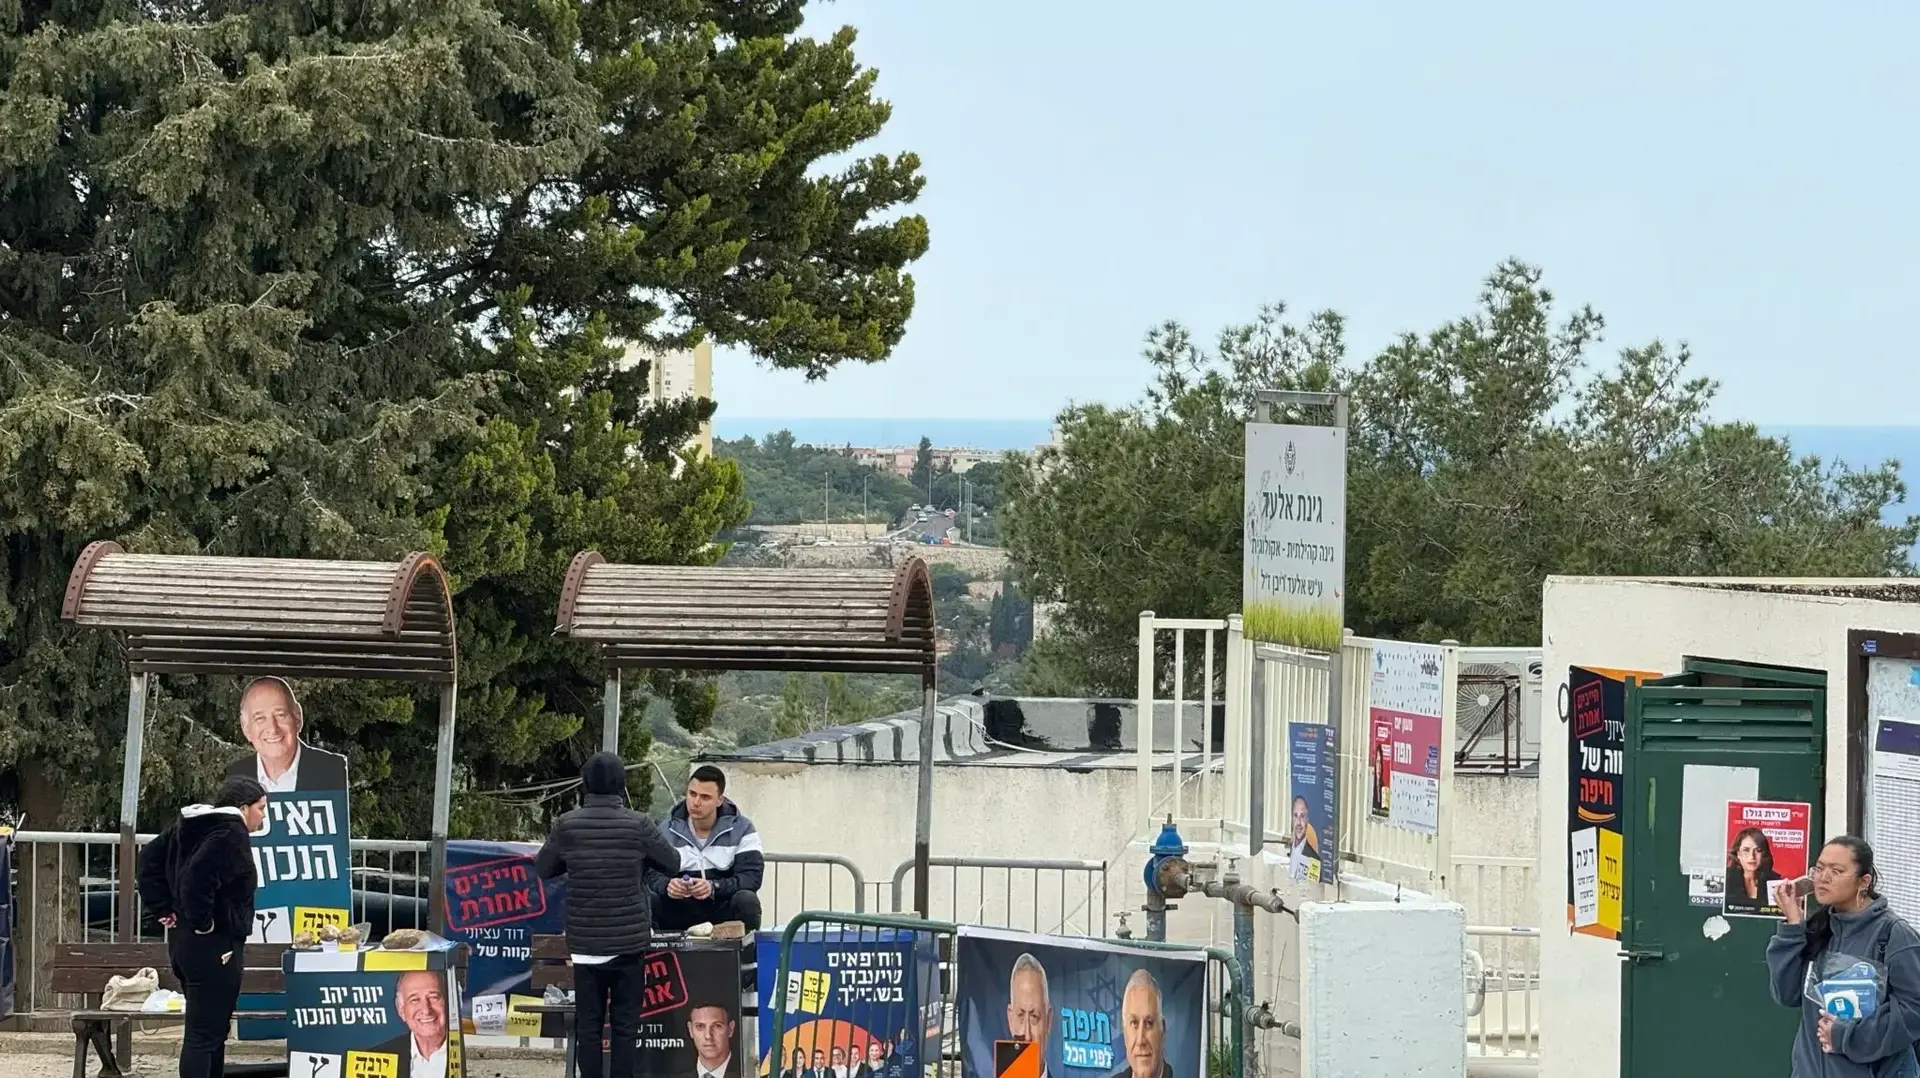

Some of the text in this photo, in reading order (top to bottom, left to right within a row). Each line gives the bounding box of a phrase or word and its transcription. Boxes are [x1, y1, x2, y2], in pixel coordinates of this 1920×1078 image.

[1296, 494, 1322, 523] גינת
[1251, 535, 1281, 560] אקולוגית
[1286, 538, 1317, 564] קהילתית
[1319, 546, 1334, 562] גינה
[1286, 574, 1306, 595] אלעד
[1577, 689, 1600, 709] חייבים
[1578, 708, 1600, 730] אחרת
[1604, 720, 1626, 742] ציוני
[1580, 740, 1601, 772] של
[1580, 777, 1613, 806] חיפה
[1744, 808, 1763, 818] גולן
[1764, 810, 1789, 819] שרית
[251, 844, 339, 887] הנכון
[1576, 848, 1594, 868] דעת
[1605, 856, 1617, 875] דוד
[454, 864, 528, 895] חייבים
[1600, 879, 1620, 900] עציוני
[460, 887, 532, 921] אחרת
[464, 927, 525, 940] דוד עציוני
[476, 942, 498, 957] של
[319, 985, 384, 1004] יונה יהב
[340, 1007, 387, 1025] האיש
[510, 1017, 538, 1027] עציוני
[1061, 1006, 1112, 1045] חיפה
[648, 1023, 664, 1034] דוד
[644, 1038, 685, 1050] התקווה
[354, 1055, 390, 1072] יונה
[1064, 1041, 1113, 1069] לפני הכל
